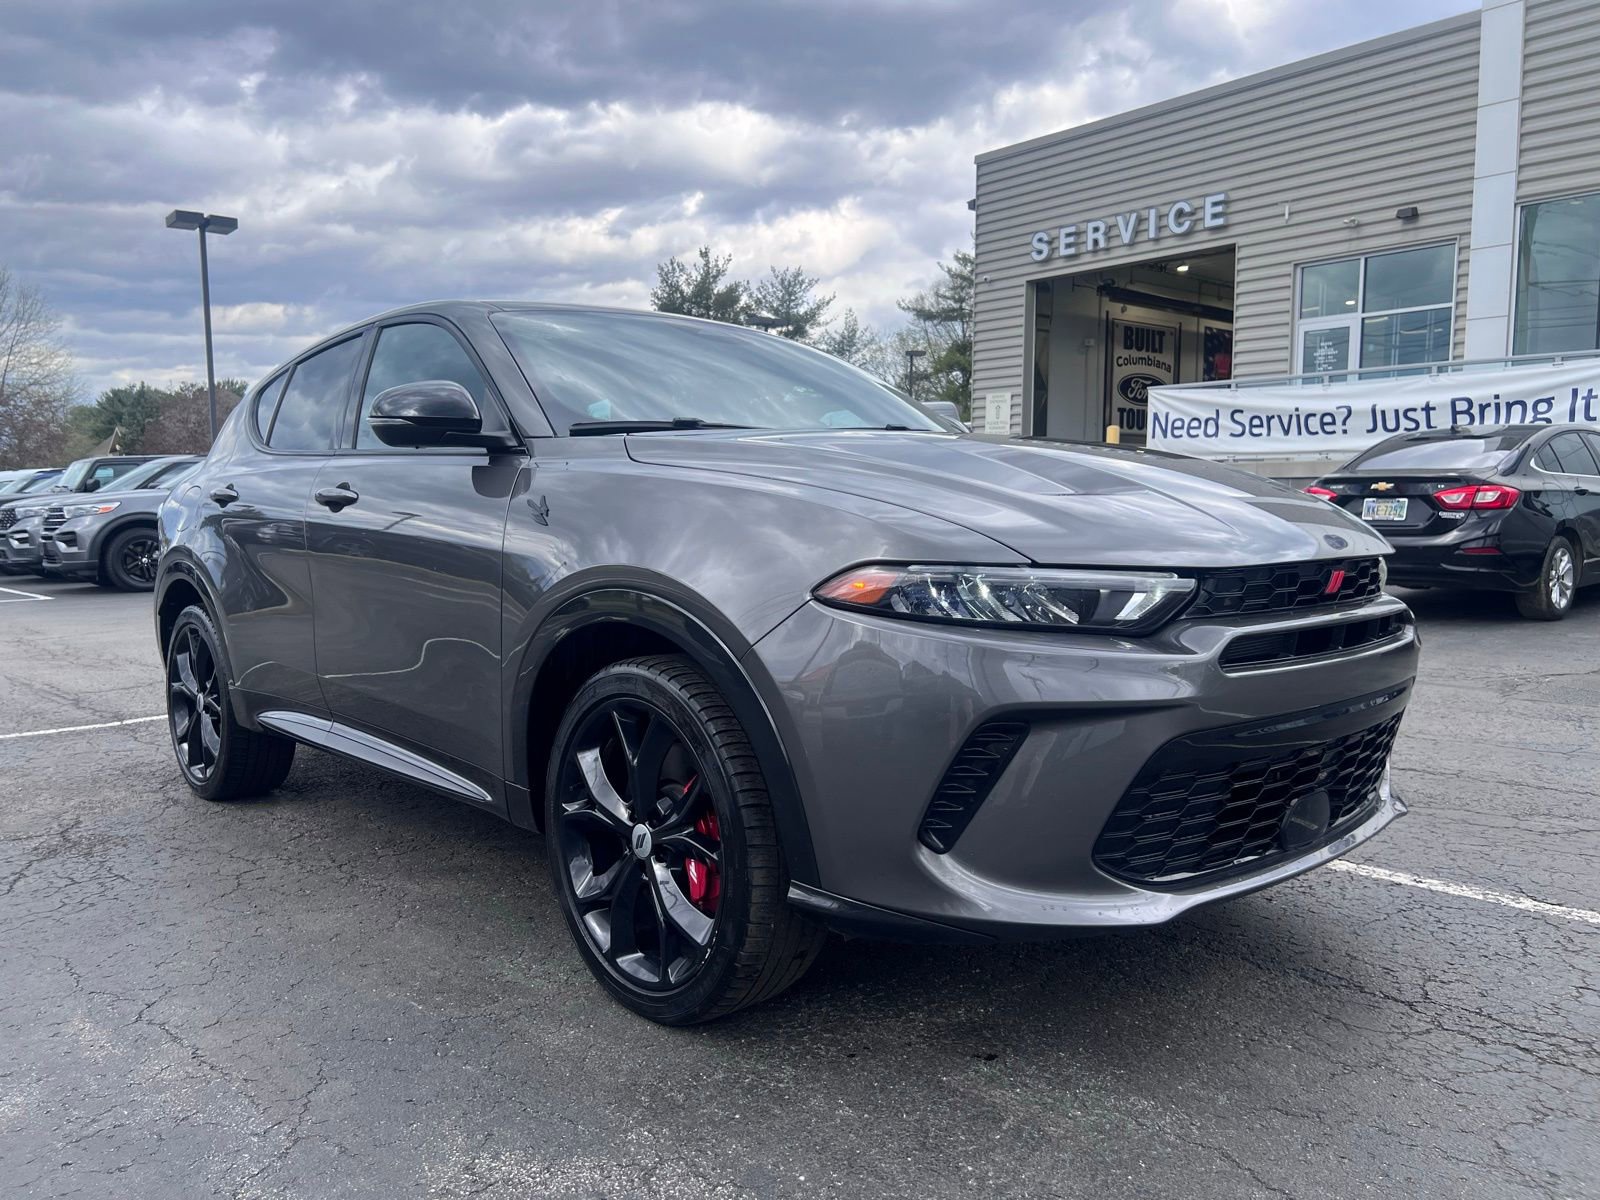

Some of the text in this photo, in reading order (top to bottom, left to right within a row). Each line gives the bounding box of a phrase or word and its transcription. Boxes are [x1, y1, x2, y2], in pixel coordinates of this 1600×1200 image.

[1031, 192, 1227, 262] SERVICE
[1123, 325, 1166, 354] BUILT
[1116, 354, 1172, 374] Columbiana
[1127, 377, 1152, 399] For
[1117, 407, 1147, 430] TOU
[1151, 387, 1599, 439] Need Service? Just Bring It
